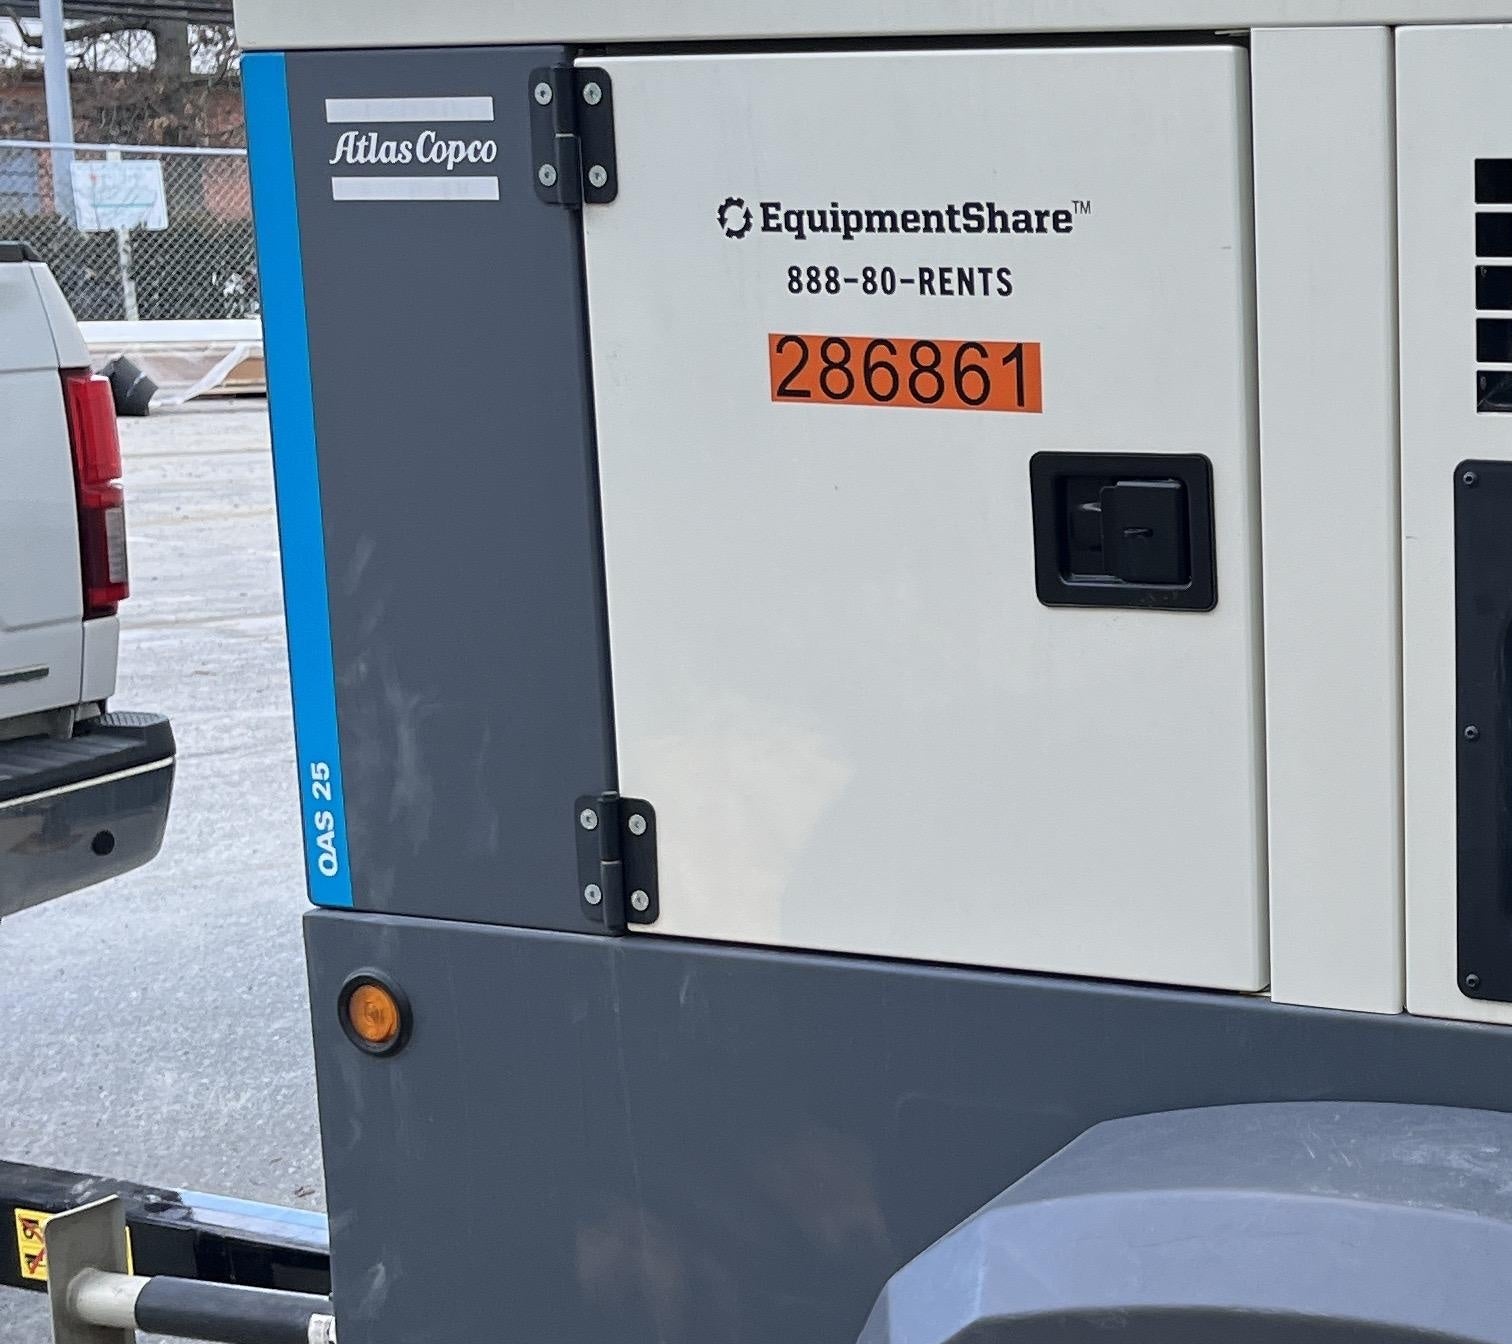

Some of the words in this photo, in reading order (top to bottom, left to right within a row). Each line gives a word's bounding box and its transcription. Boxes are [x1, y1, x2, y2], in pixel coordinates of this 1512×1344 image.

[328, 130, 413, 165] Atlas
[415, 129, 498, 171] Copco
[787, 265, 1014, 297] 888-80-RENTS
[775, 334, 1027, 408] 286861
[310, 761, 332, 802] 25
[314, 810, 339, 877] QAS
